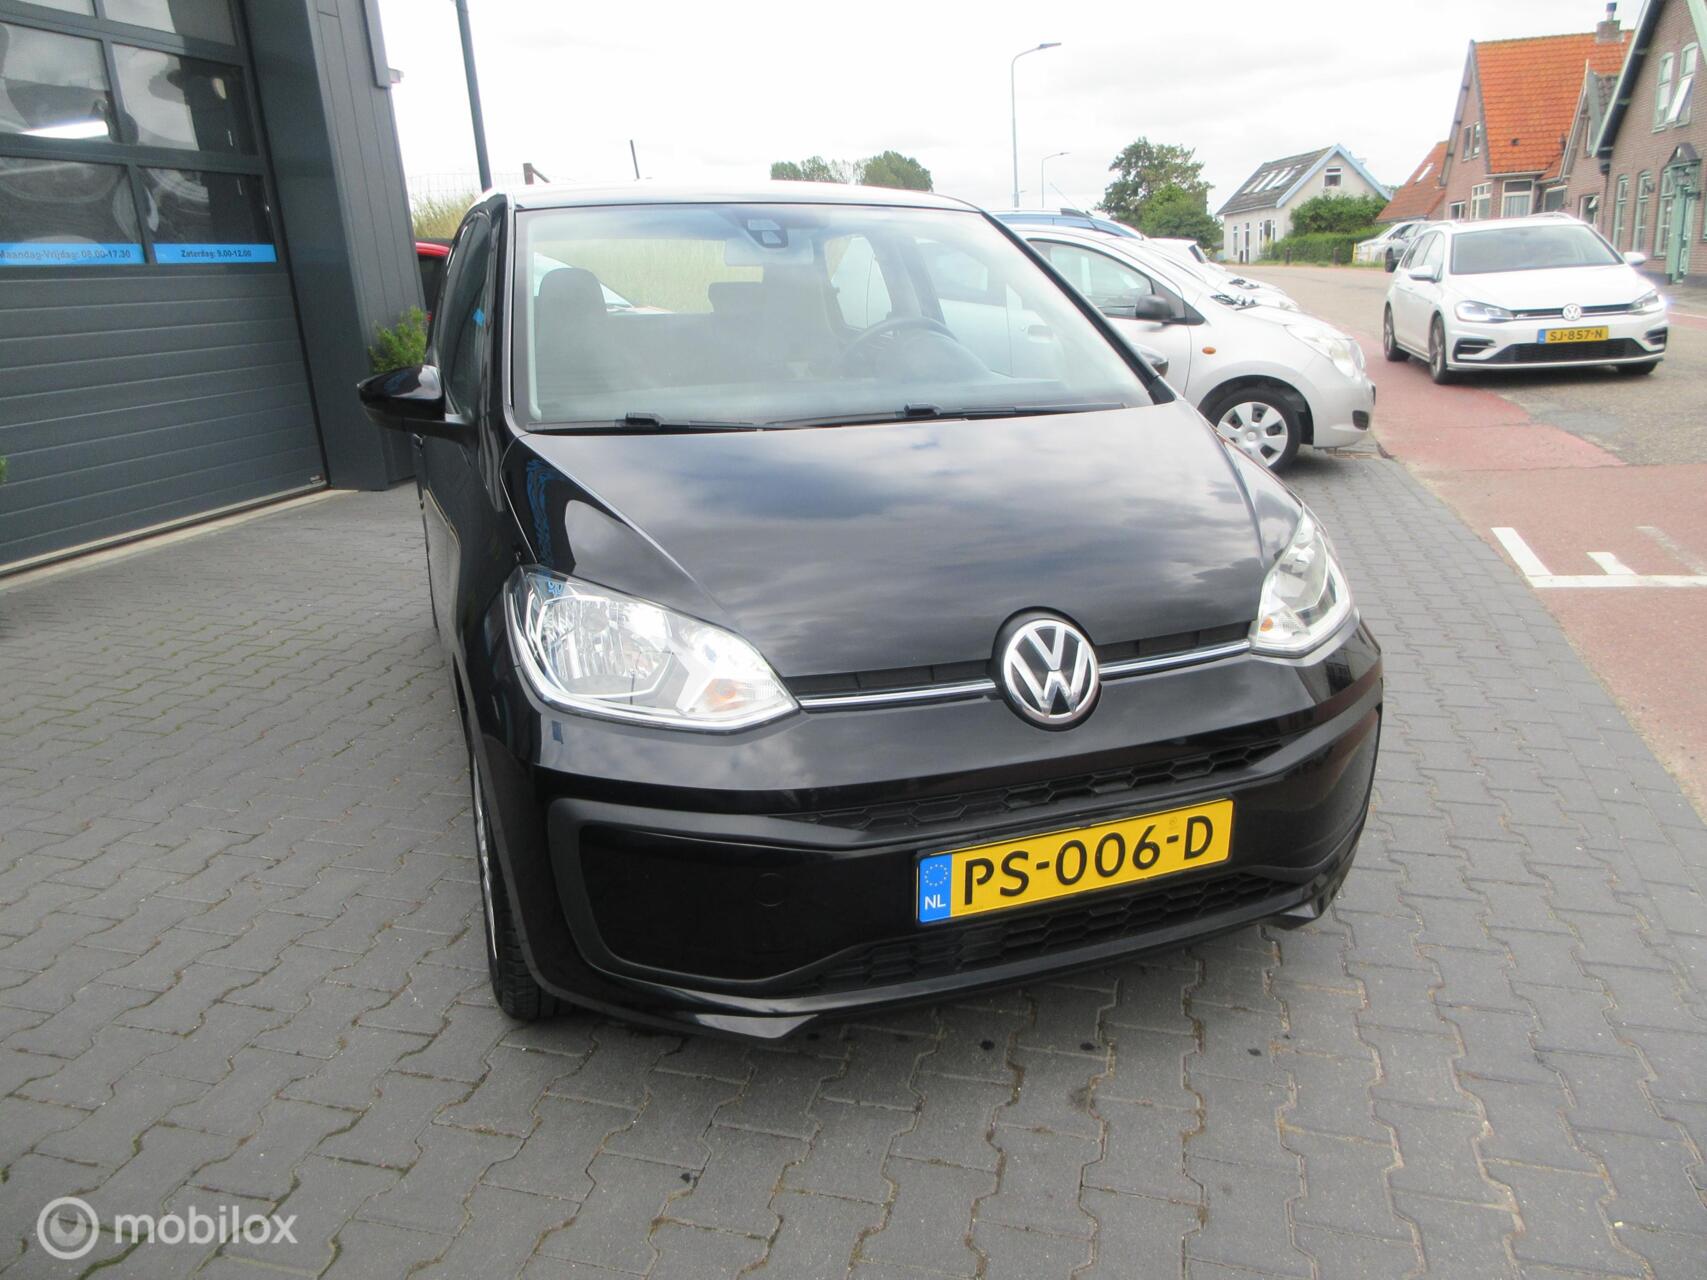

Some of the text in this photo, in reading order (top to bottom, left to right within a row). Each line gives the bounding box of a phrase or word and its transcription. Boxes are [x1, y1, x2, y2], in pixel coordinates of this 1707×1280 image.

[1549, 329, 1603, 341] SJ-857-N
[1005, 621, 1096, 720] VW
[963, 815, 1213, 906] PS-006-D
[924, 894, 946, 911] NL
